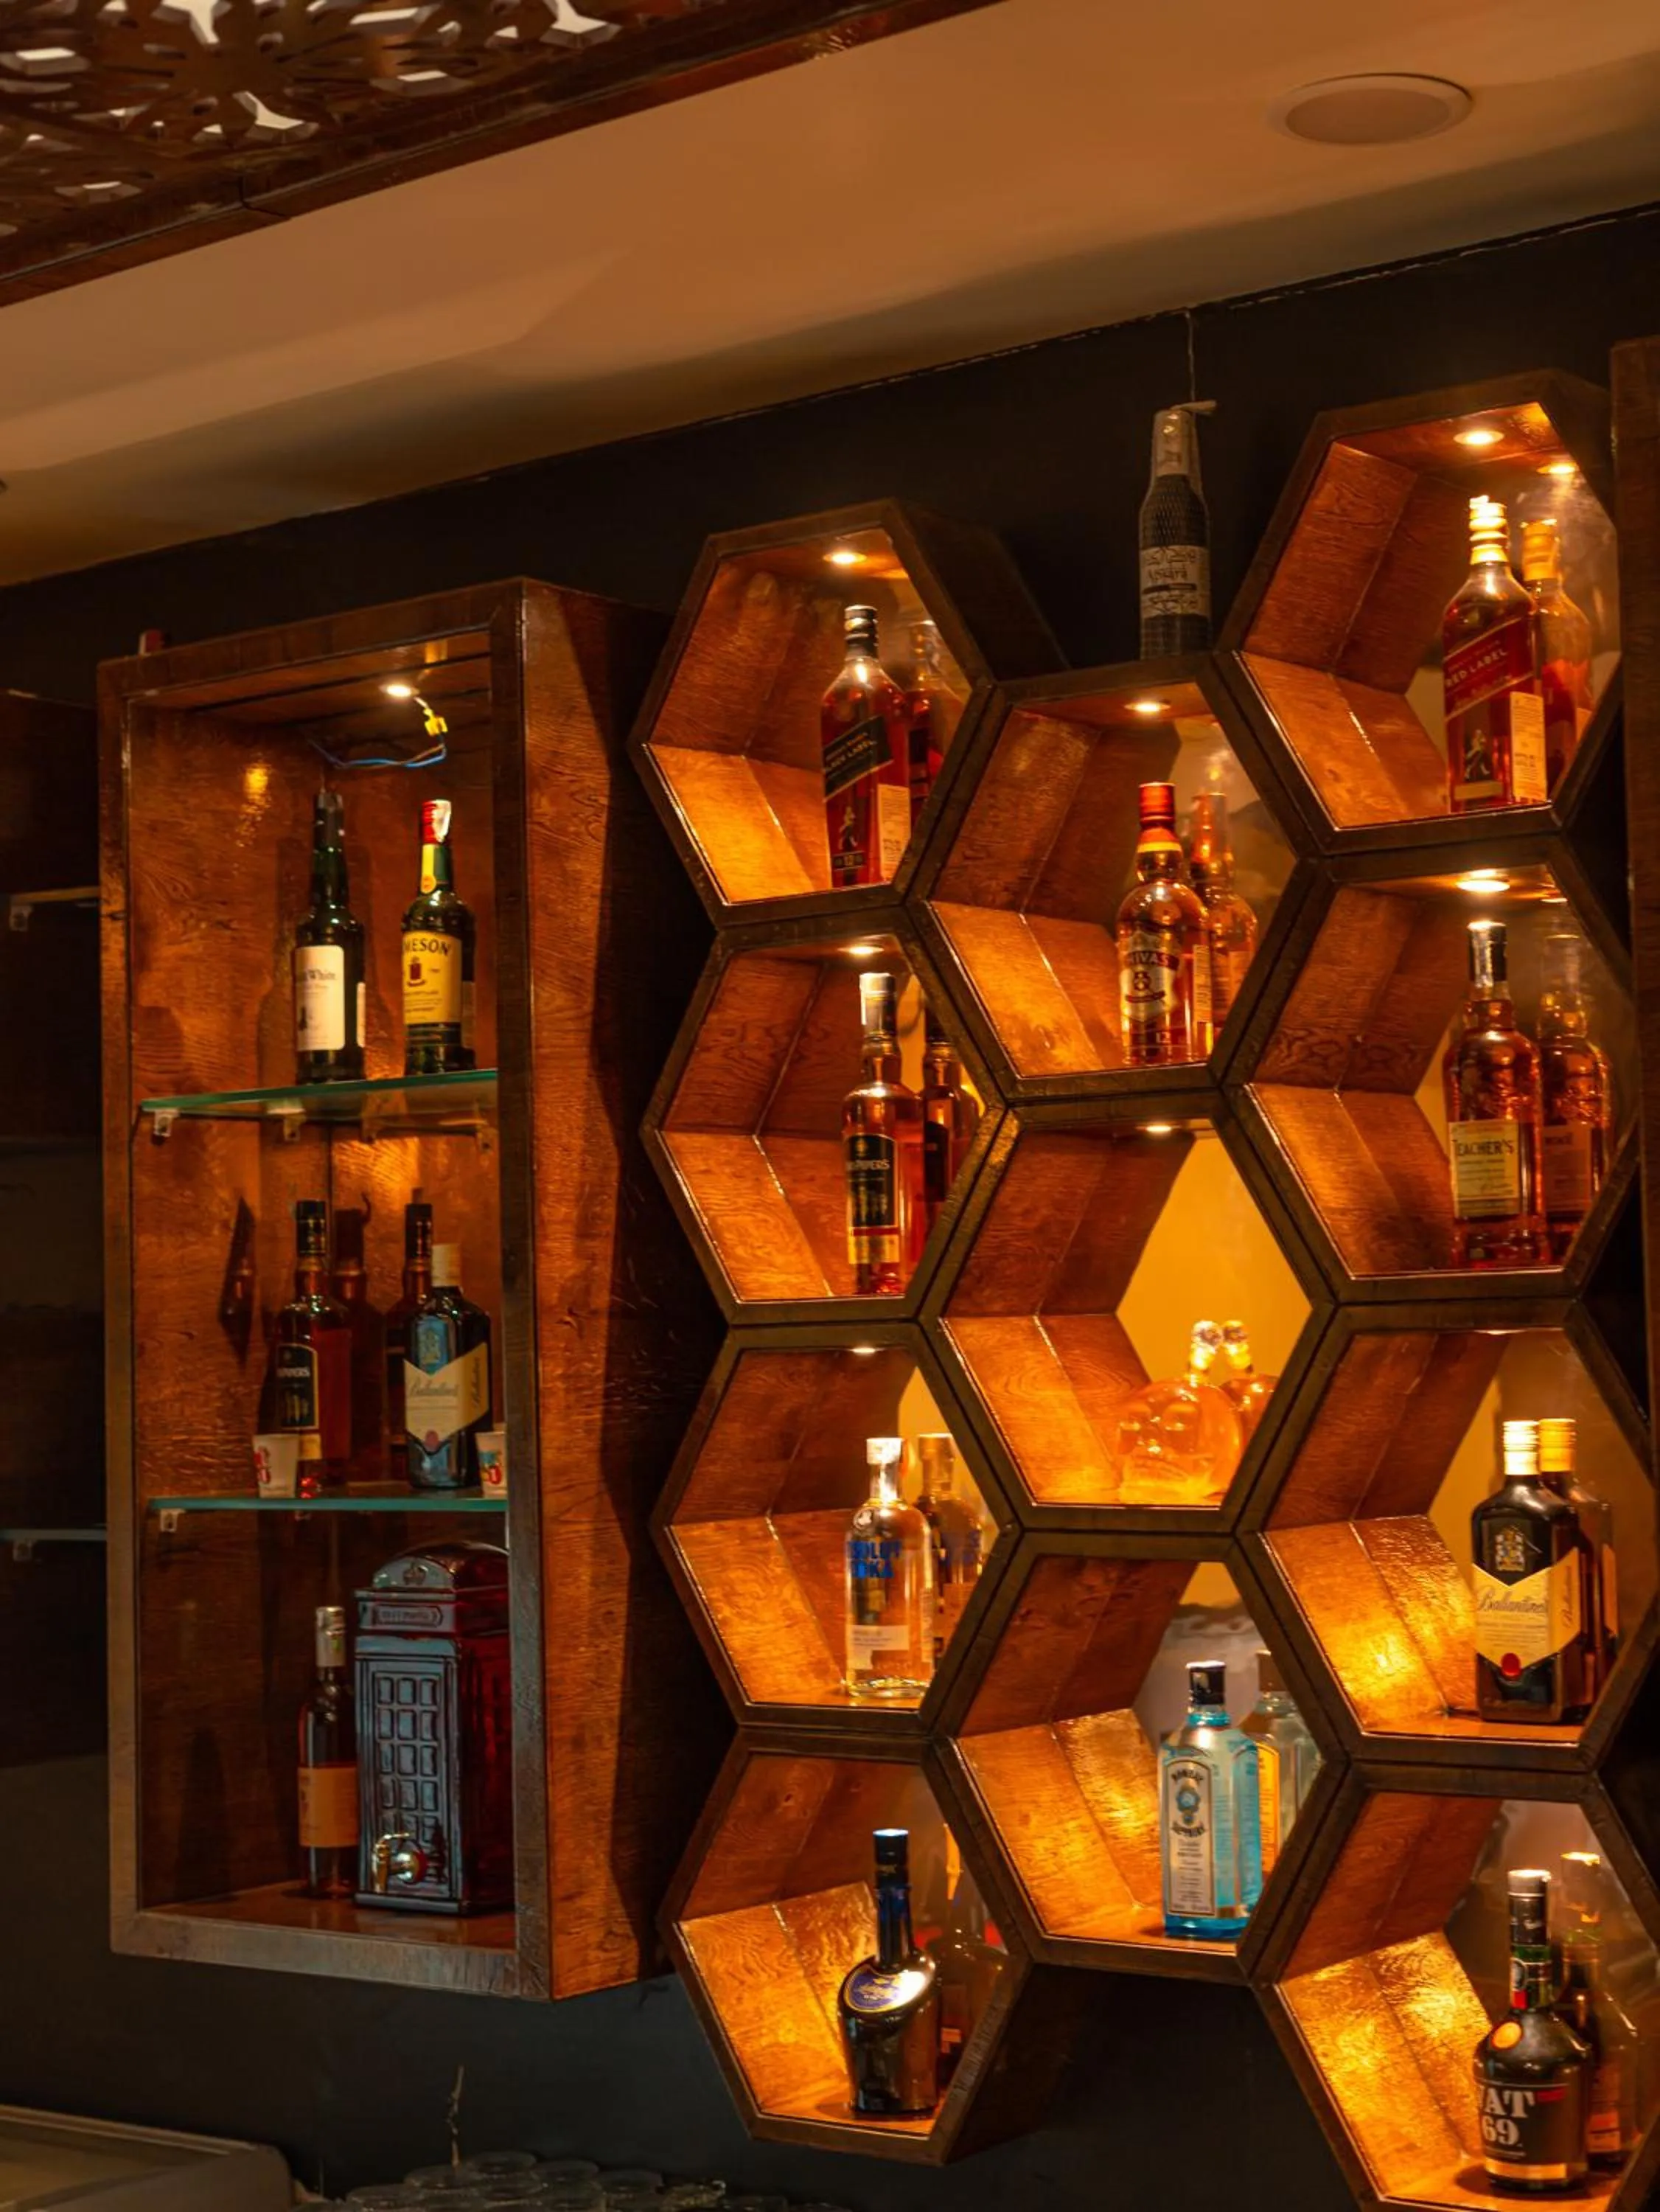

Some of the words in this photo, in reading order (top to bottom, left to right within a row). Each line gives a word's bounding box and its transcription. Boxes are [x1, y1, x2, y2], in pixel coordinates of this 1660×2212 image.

[1469, 648, 1508, 672] LABEL
[1479, 2084, 1535, 2118] AT
[1481, 2114, 1519, 2146] 69
